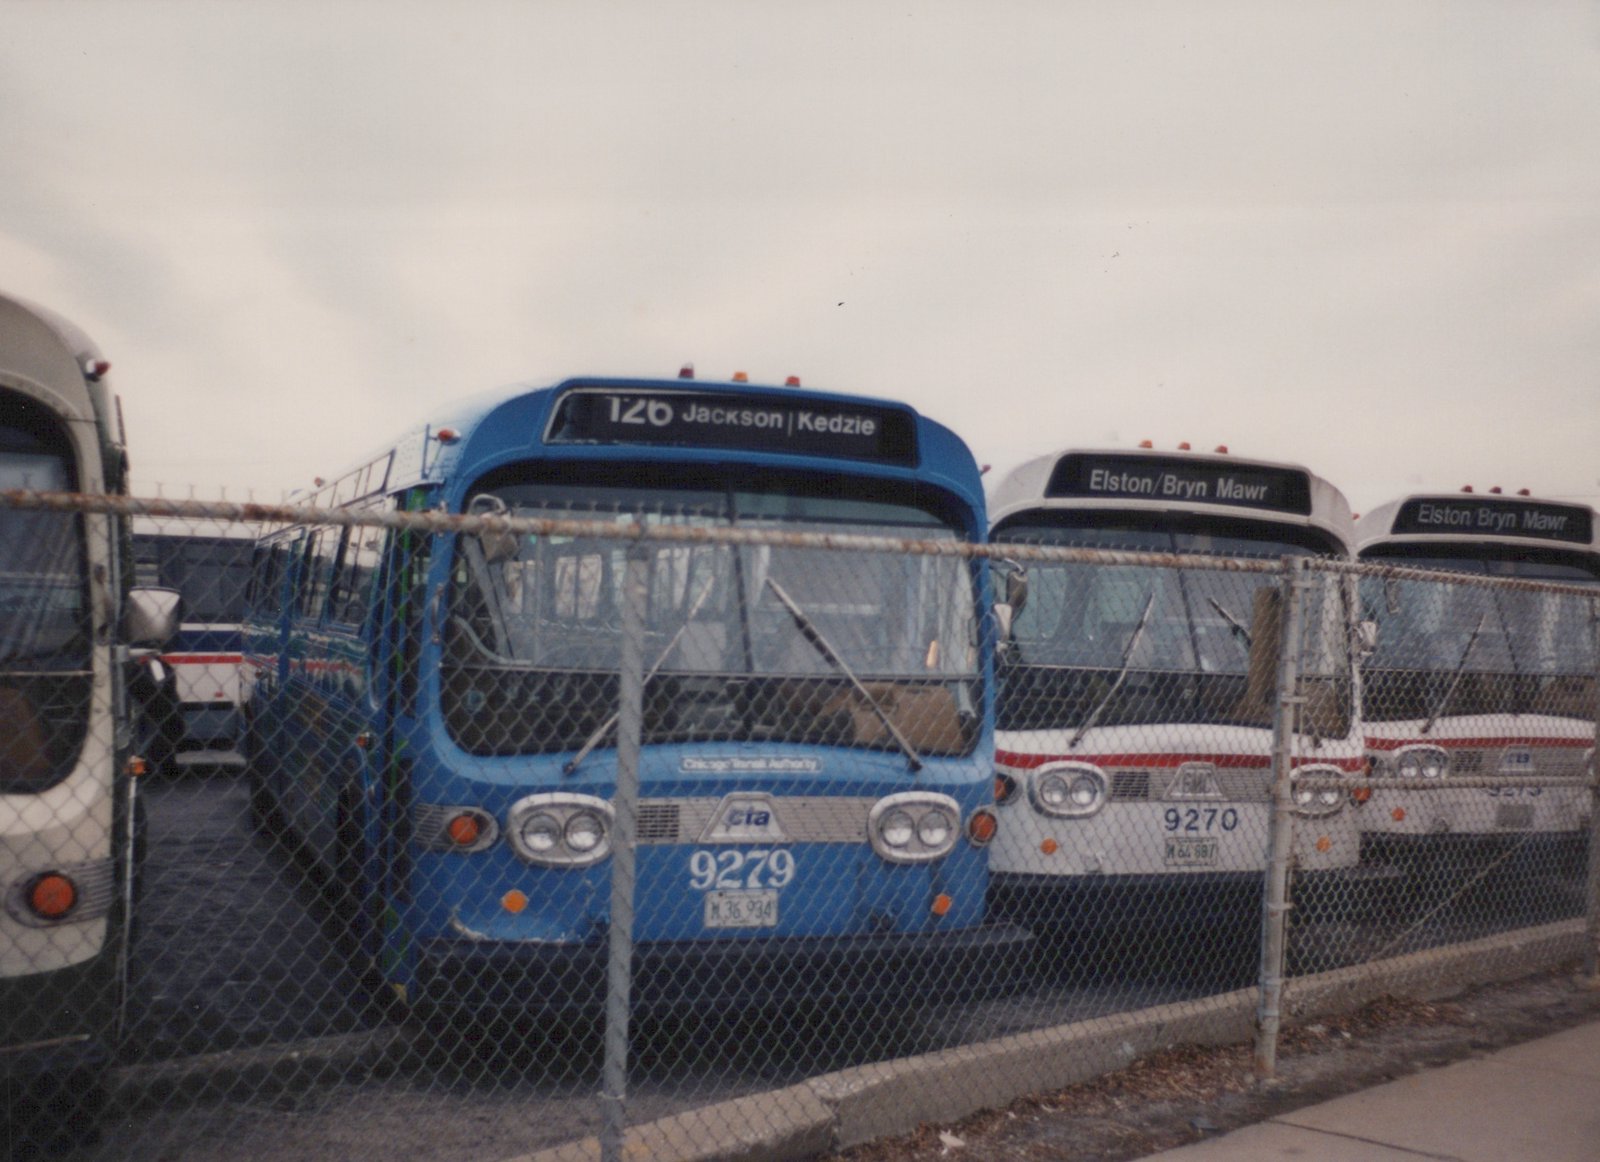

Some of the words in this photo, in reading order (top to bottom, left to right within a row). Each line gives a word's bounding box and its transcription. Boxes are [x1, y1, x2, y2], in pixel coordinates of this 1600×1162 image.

[605, 396, 674, 427] 126
[682, 403, 783, 429] Jackson
[797, 411, 876, 436] Kedzie
[1216, 477, 1268, 500] Mawr
[1417, 504, 1471, 525] Elston
[1477, 507, 1517, 532] Bryn
[1523, 511, 1568, 531] Mawr
[769, 758, 818, 771] Authority
[1164, 807, 1239, 832] 9270
[689, 849, 796, 890] 9279
